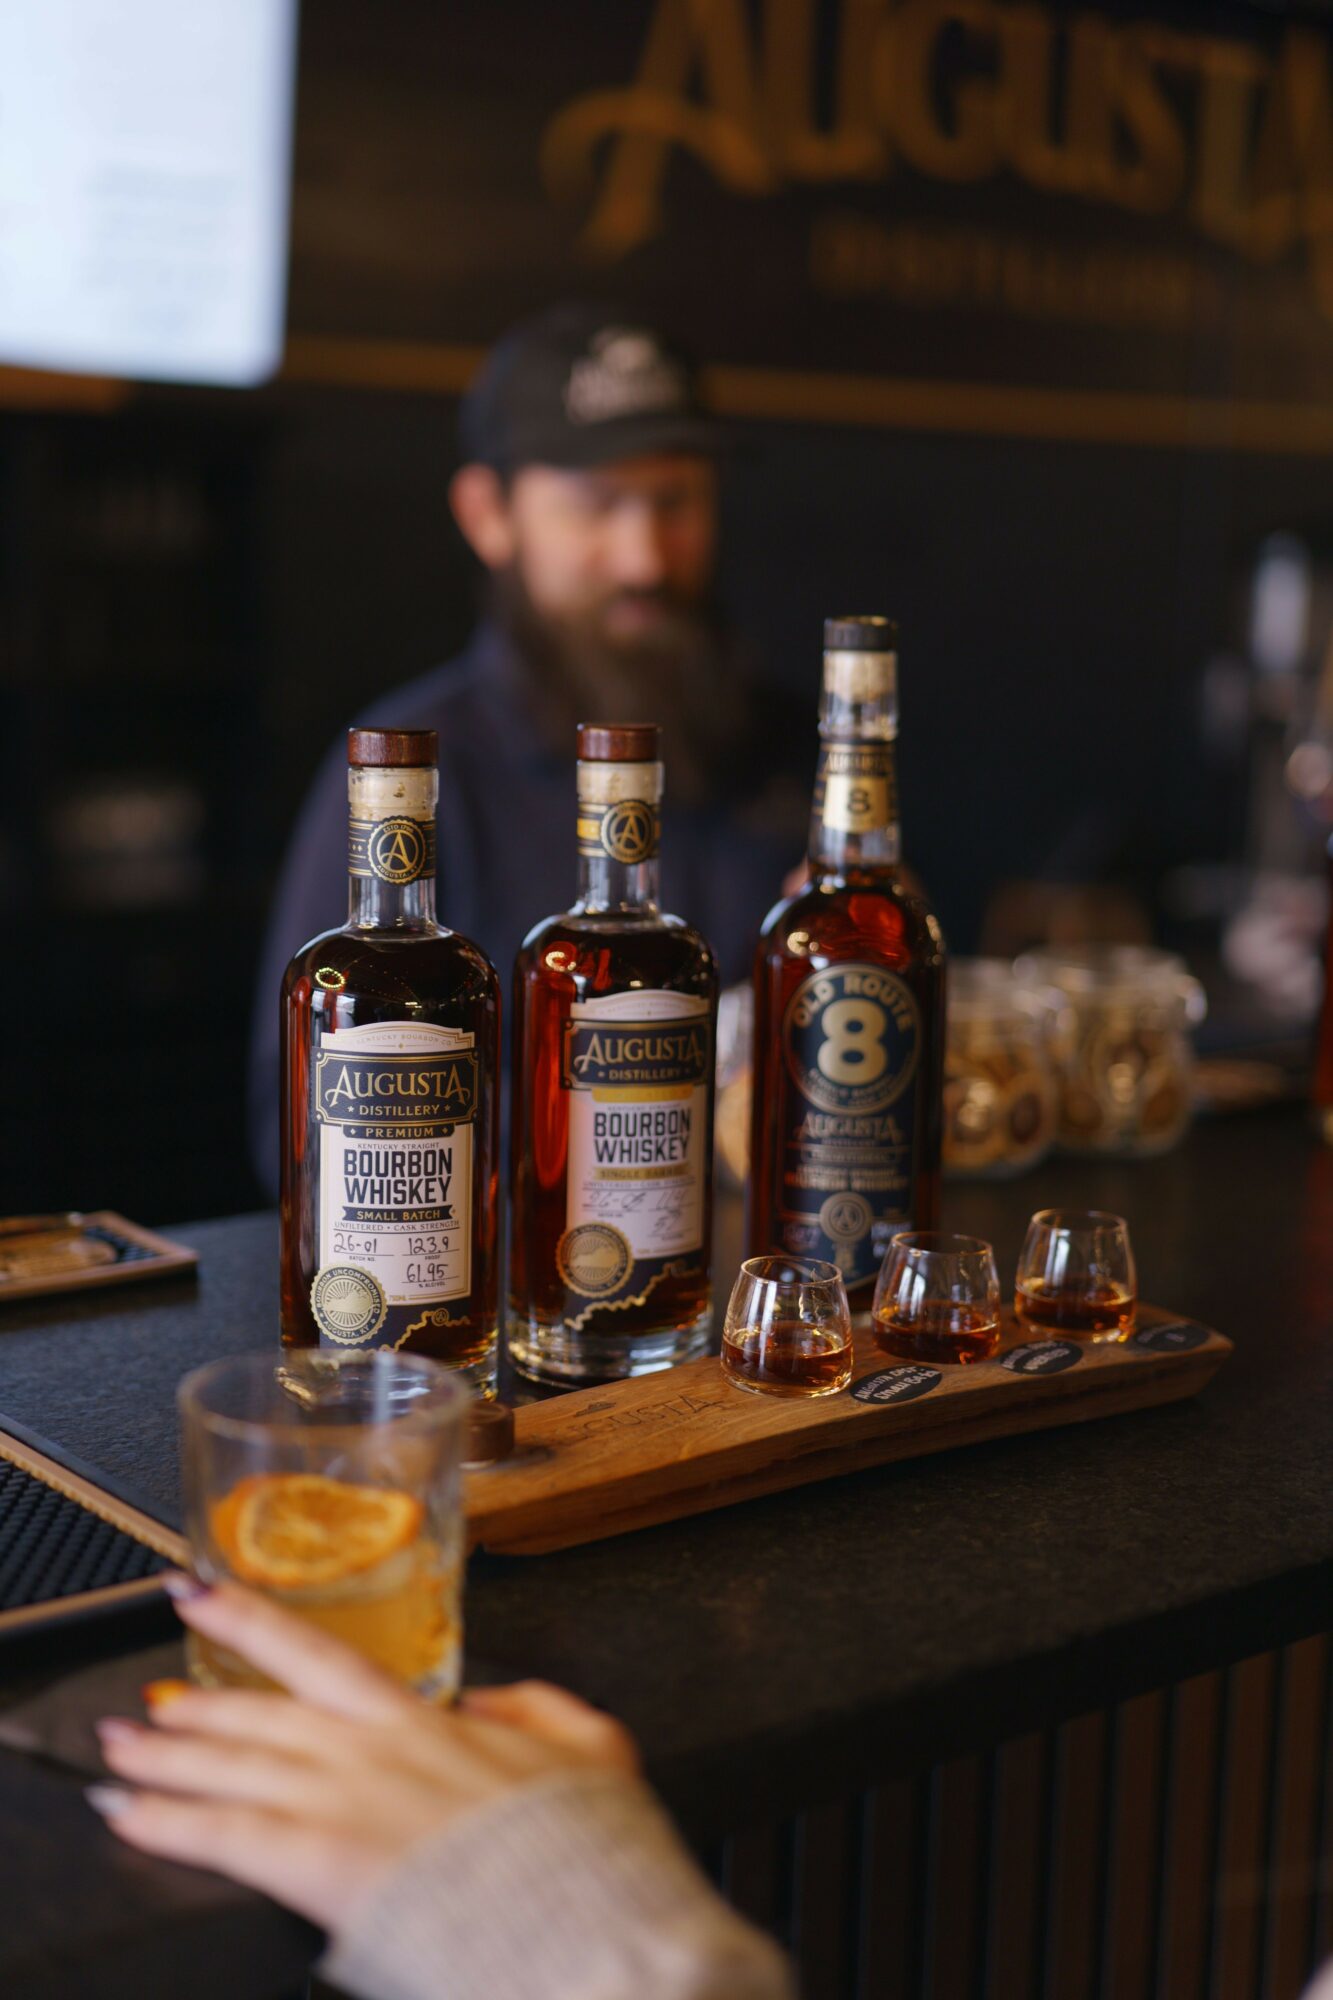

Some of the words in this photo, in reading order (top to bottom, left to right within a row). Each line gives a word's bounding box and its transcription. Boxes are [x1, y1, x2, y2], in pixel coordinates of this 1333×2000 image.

[848, 788, 871, 815] 8
[614, 813, 645, 851] A
[379, 830, 415, 870] A
[573, 1031, 704, 1074] AUGUSTA
[817, 997, 888, 1086] 8
[325, 1064, 471, 1108] AUGUSTA
[608, 1068, 681, 1081] DISTILLERY
[359, 1104, 440, 1116] DISTILLERY
[593, 1108, 691, 1137] BOURBON
[365, 1127, 435, 1138] PREMIUM
[795, 1112, 903, 1144] AUGUSTA
[401, 1142, 440, 1150] STRAIGHT
[594, 1136, 690, 1164] WHISKEY
[343, 1148, 453, 1178] BOURBON
[343, 1176, 453, 1205] WHISKEY
[334, 1221, 384, 1232] UNFILTERED
[393, 1223, 417, 1232] CASK
[419, 1220, 460, 1231] STRENGTH
[356, 1210, 398, 1221] SMALL
[402, 1210, 441, 1221] BATCH
[333, 1232, 378, 1254] 26-01
[408, 1235, 449, 1255] 123.9
[406, 1262, 449, 1283] 61.95
[315, 1273, 333, 1309] BOURBON
[332, 1268, 381, 1315] UNCOMPROMISED
[323, 1320, 359, 1338] AUGUSTA,
[359, 1324, 370, 1335] KY
